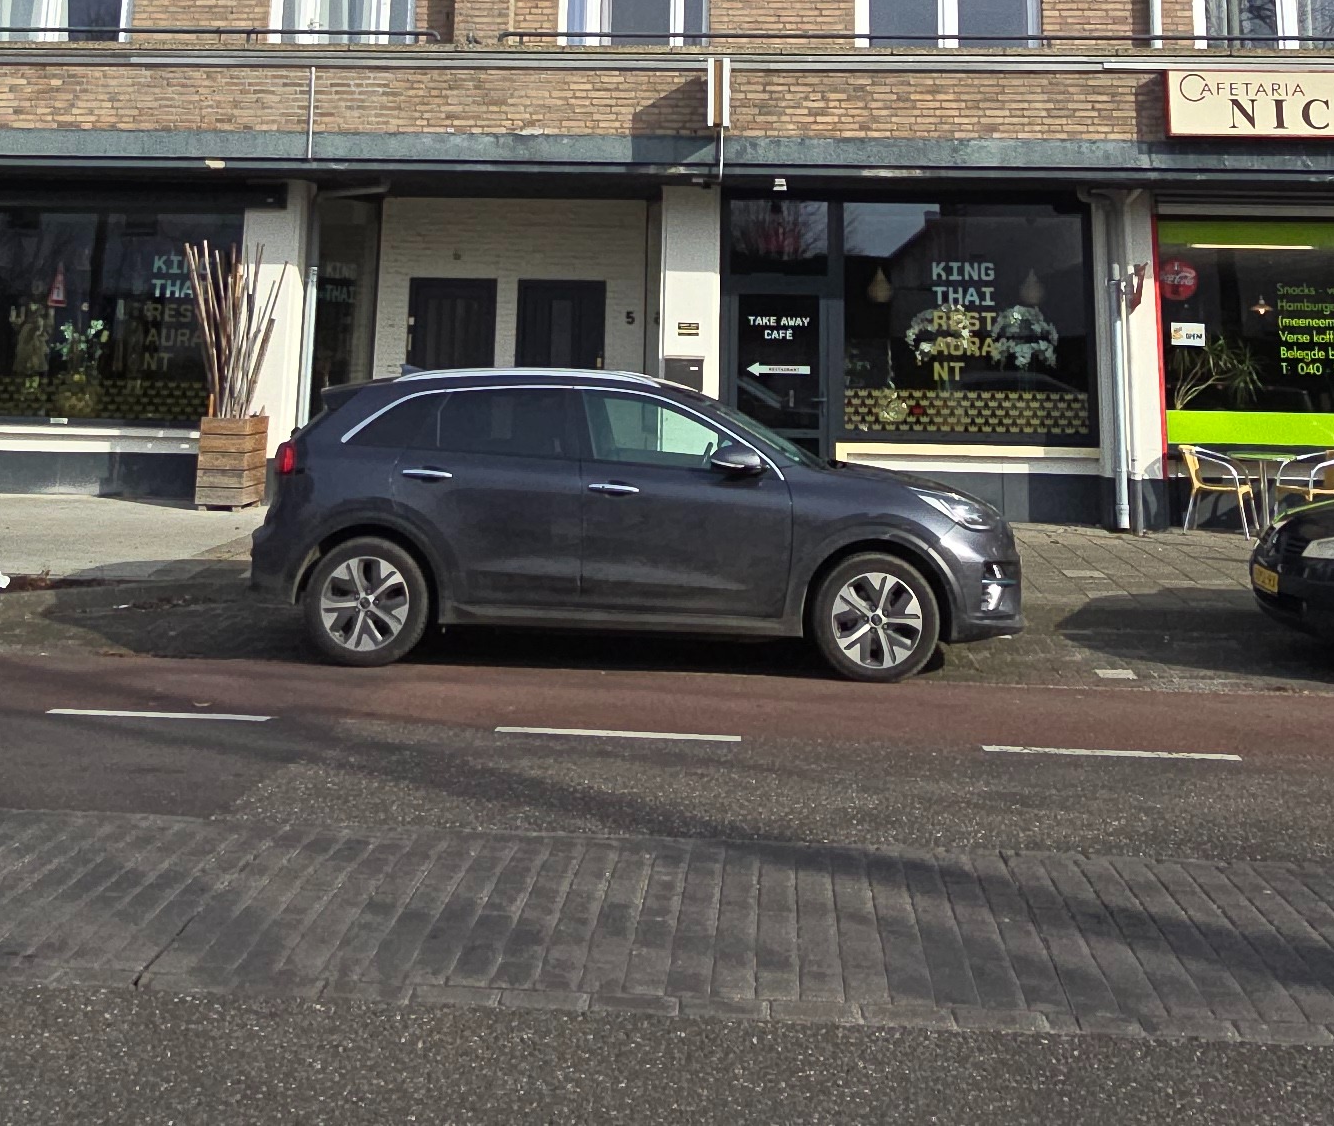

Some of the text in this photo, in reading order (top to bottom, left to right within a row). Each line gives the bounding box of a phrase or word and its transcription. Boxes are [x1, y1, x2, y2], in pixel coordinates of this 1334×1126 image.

[1179, 73, 1306, 102] CAFETARIA
[931, 261, 995, 281] KING
[931, 286, 996, 306] THAI
[1276, 283, 1316, 295] Snacks
[625, 311, 636, 325] 5
[748, 316, 811, 327] TAKE AWAY
[932, 311, 997, 331] REST
[1279, 330, 1310, 343] Verse
[932, 336, 995, 357] AURA
[1280, 346, 1326, 362] Belegde
[933, 361, 965, 381] NT
[1280, 363, 1291, 375] T:
[1297, 363, 1323, 375] 040
